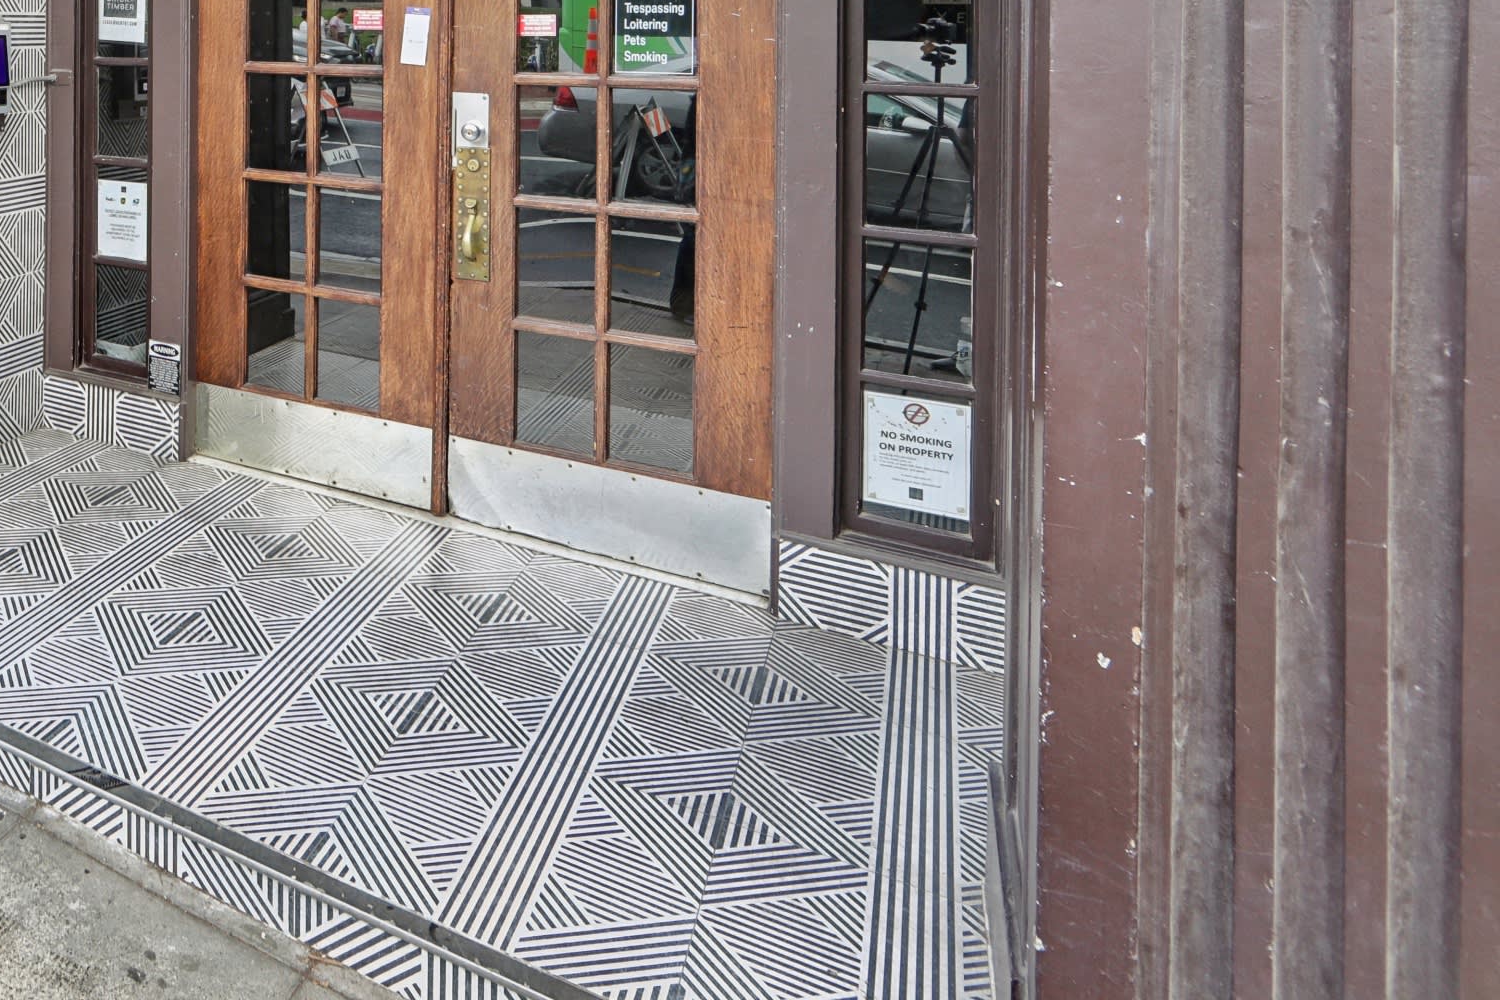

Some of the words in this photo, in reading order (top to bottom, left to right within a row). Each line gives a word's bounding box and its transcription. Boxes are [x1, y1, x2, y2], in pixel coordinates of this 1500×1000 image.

[107, 3, 134, 11] TIMBER
[624, 2, 685, 16] Trespassing
[624, 18, 668, 32] Loitering
[624, 34, 646, 46] Pets
[624, 50, 668, 64] Smoking
[880, 430, 897, 440] NO
[900, 433, 953, 449] SMOKING
[879, 442, 896, 452] ON
[899, 445, 954, 461] PROPERTY
